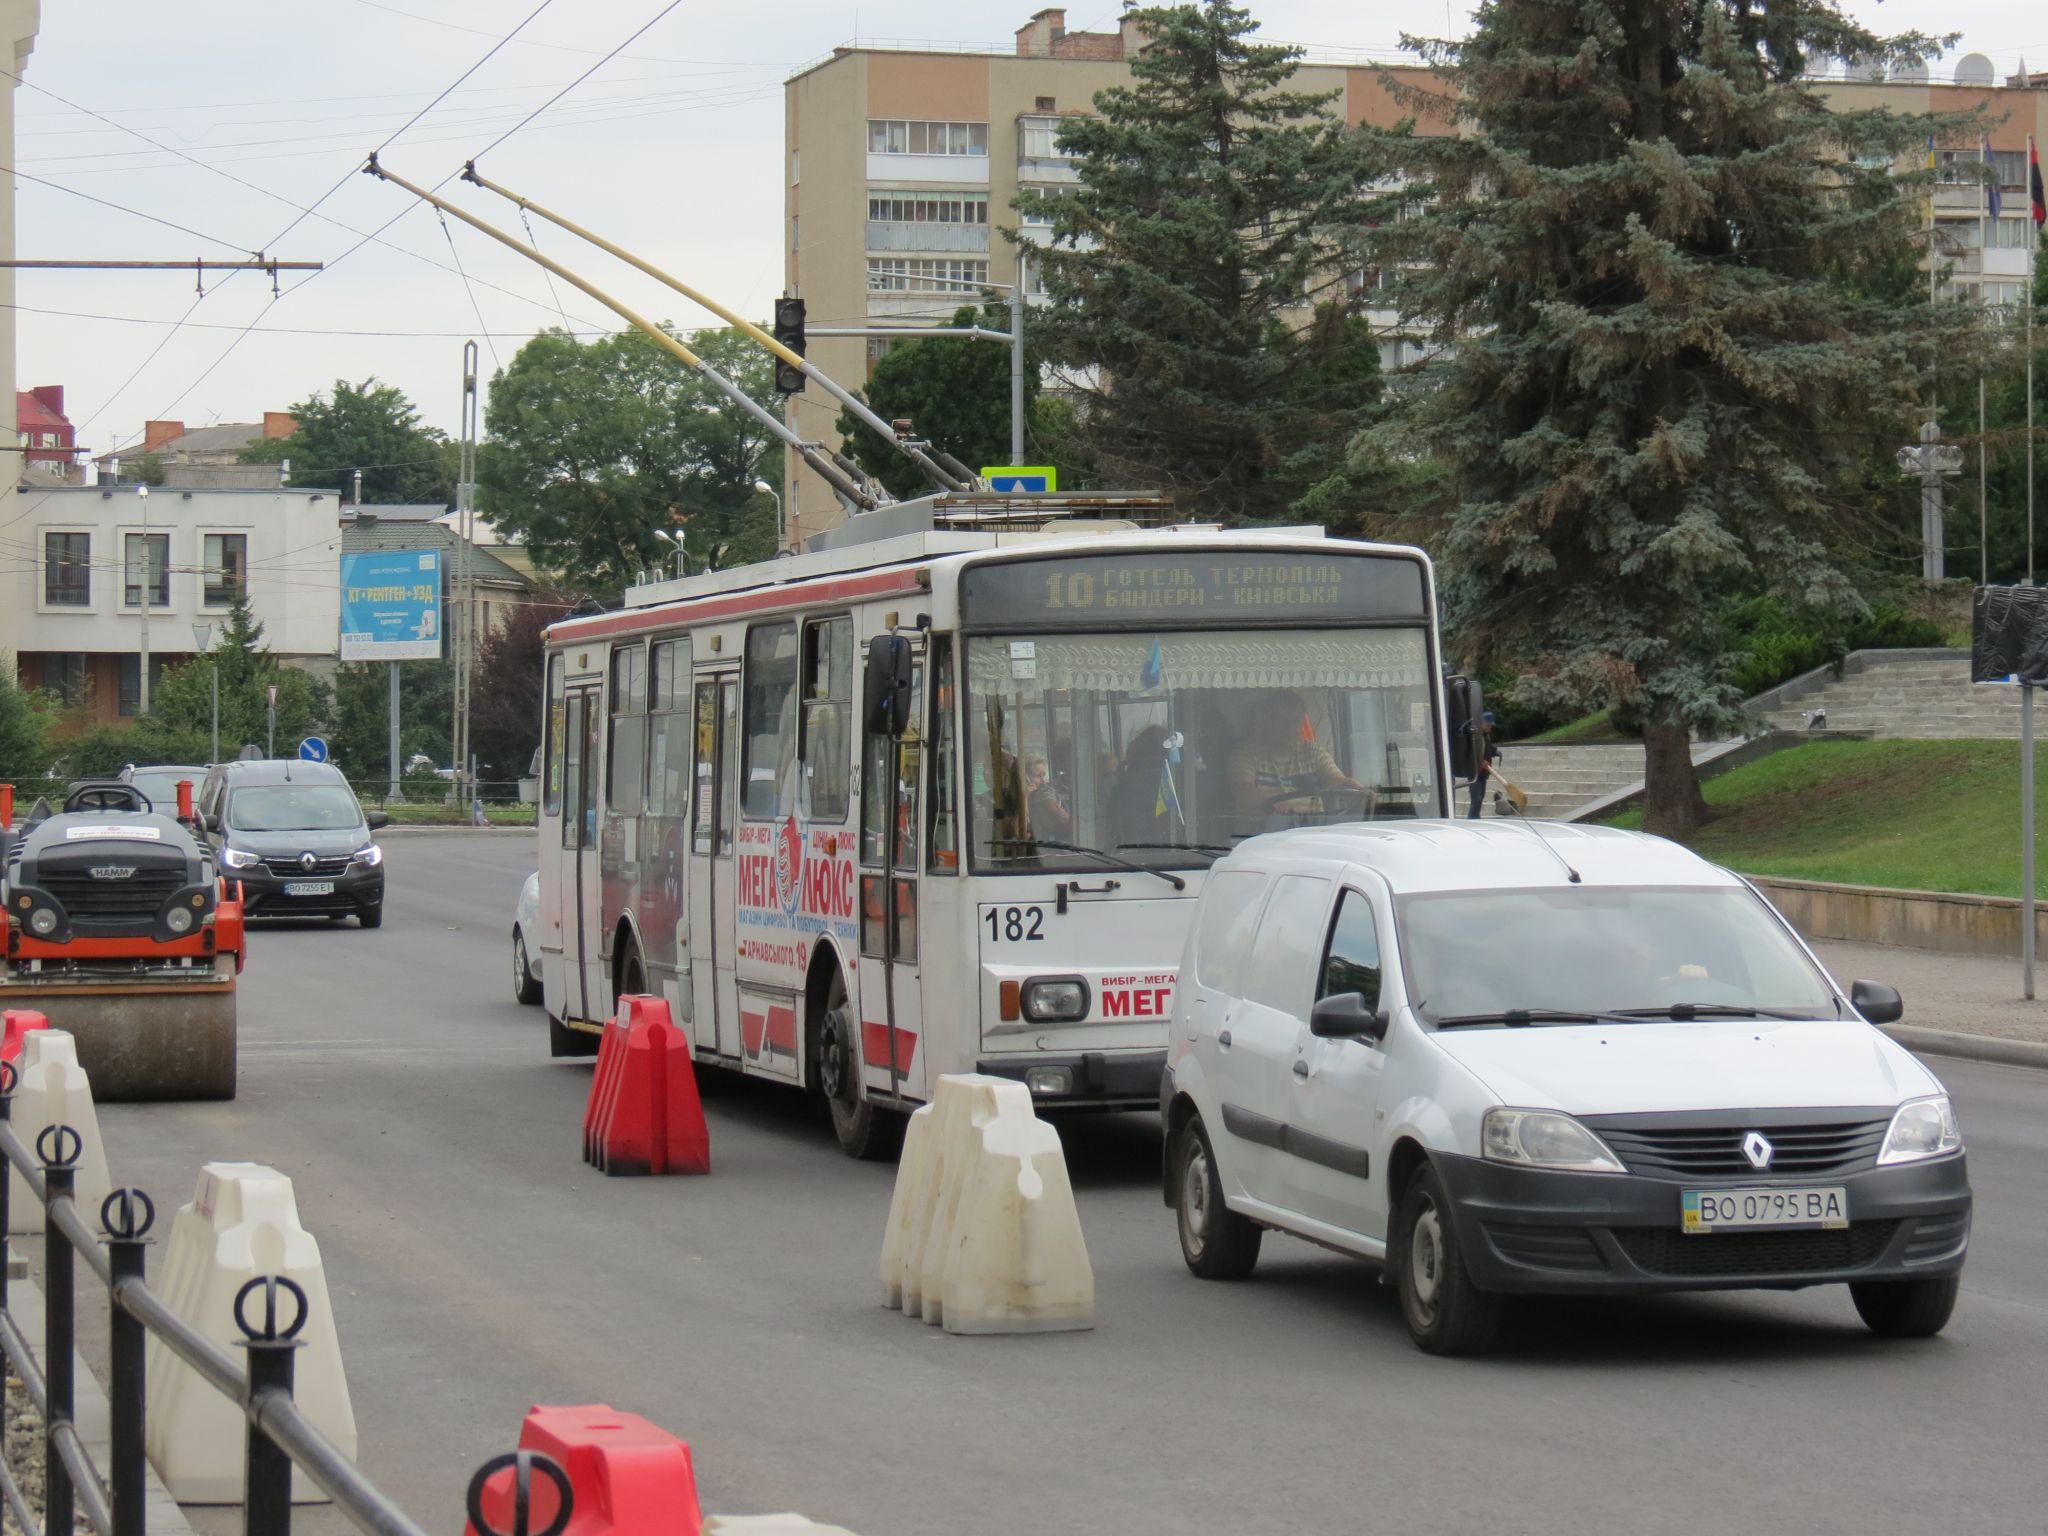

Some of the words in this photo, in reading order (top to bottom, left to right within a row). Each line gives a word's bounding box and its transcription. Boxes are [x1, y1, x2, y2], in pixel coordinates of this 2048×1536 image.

[1045, 572, 1094, 608] 10
[1103, 568, 1196, 587] ГОТЕЛЬ
[1105, 588, 1206, 607] БАНДЕРИ
[96, 868, 129, 878] HAMM
[738, 855, 778, 909] МЕГА
[801, 858, 854, 918] ЛЮКС
[985, 906, 1044, 942] 182
[796, 940, 807, 973] 19
[1102, 988, 1171, 1017] МЕГ
[1686, 1214, 1698, 1223] UA
[1701, 1197, 1736, 1222] BO
[1744, 1194, 1799, 1219] 0795
[1807, 1192, 1840, 1218] BA
